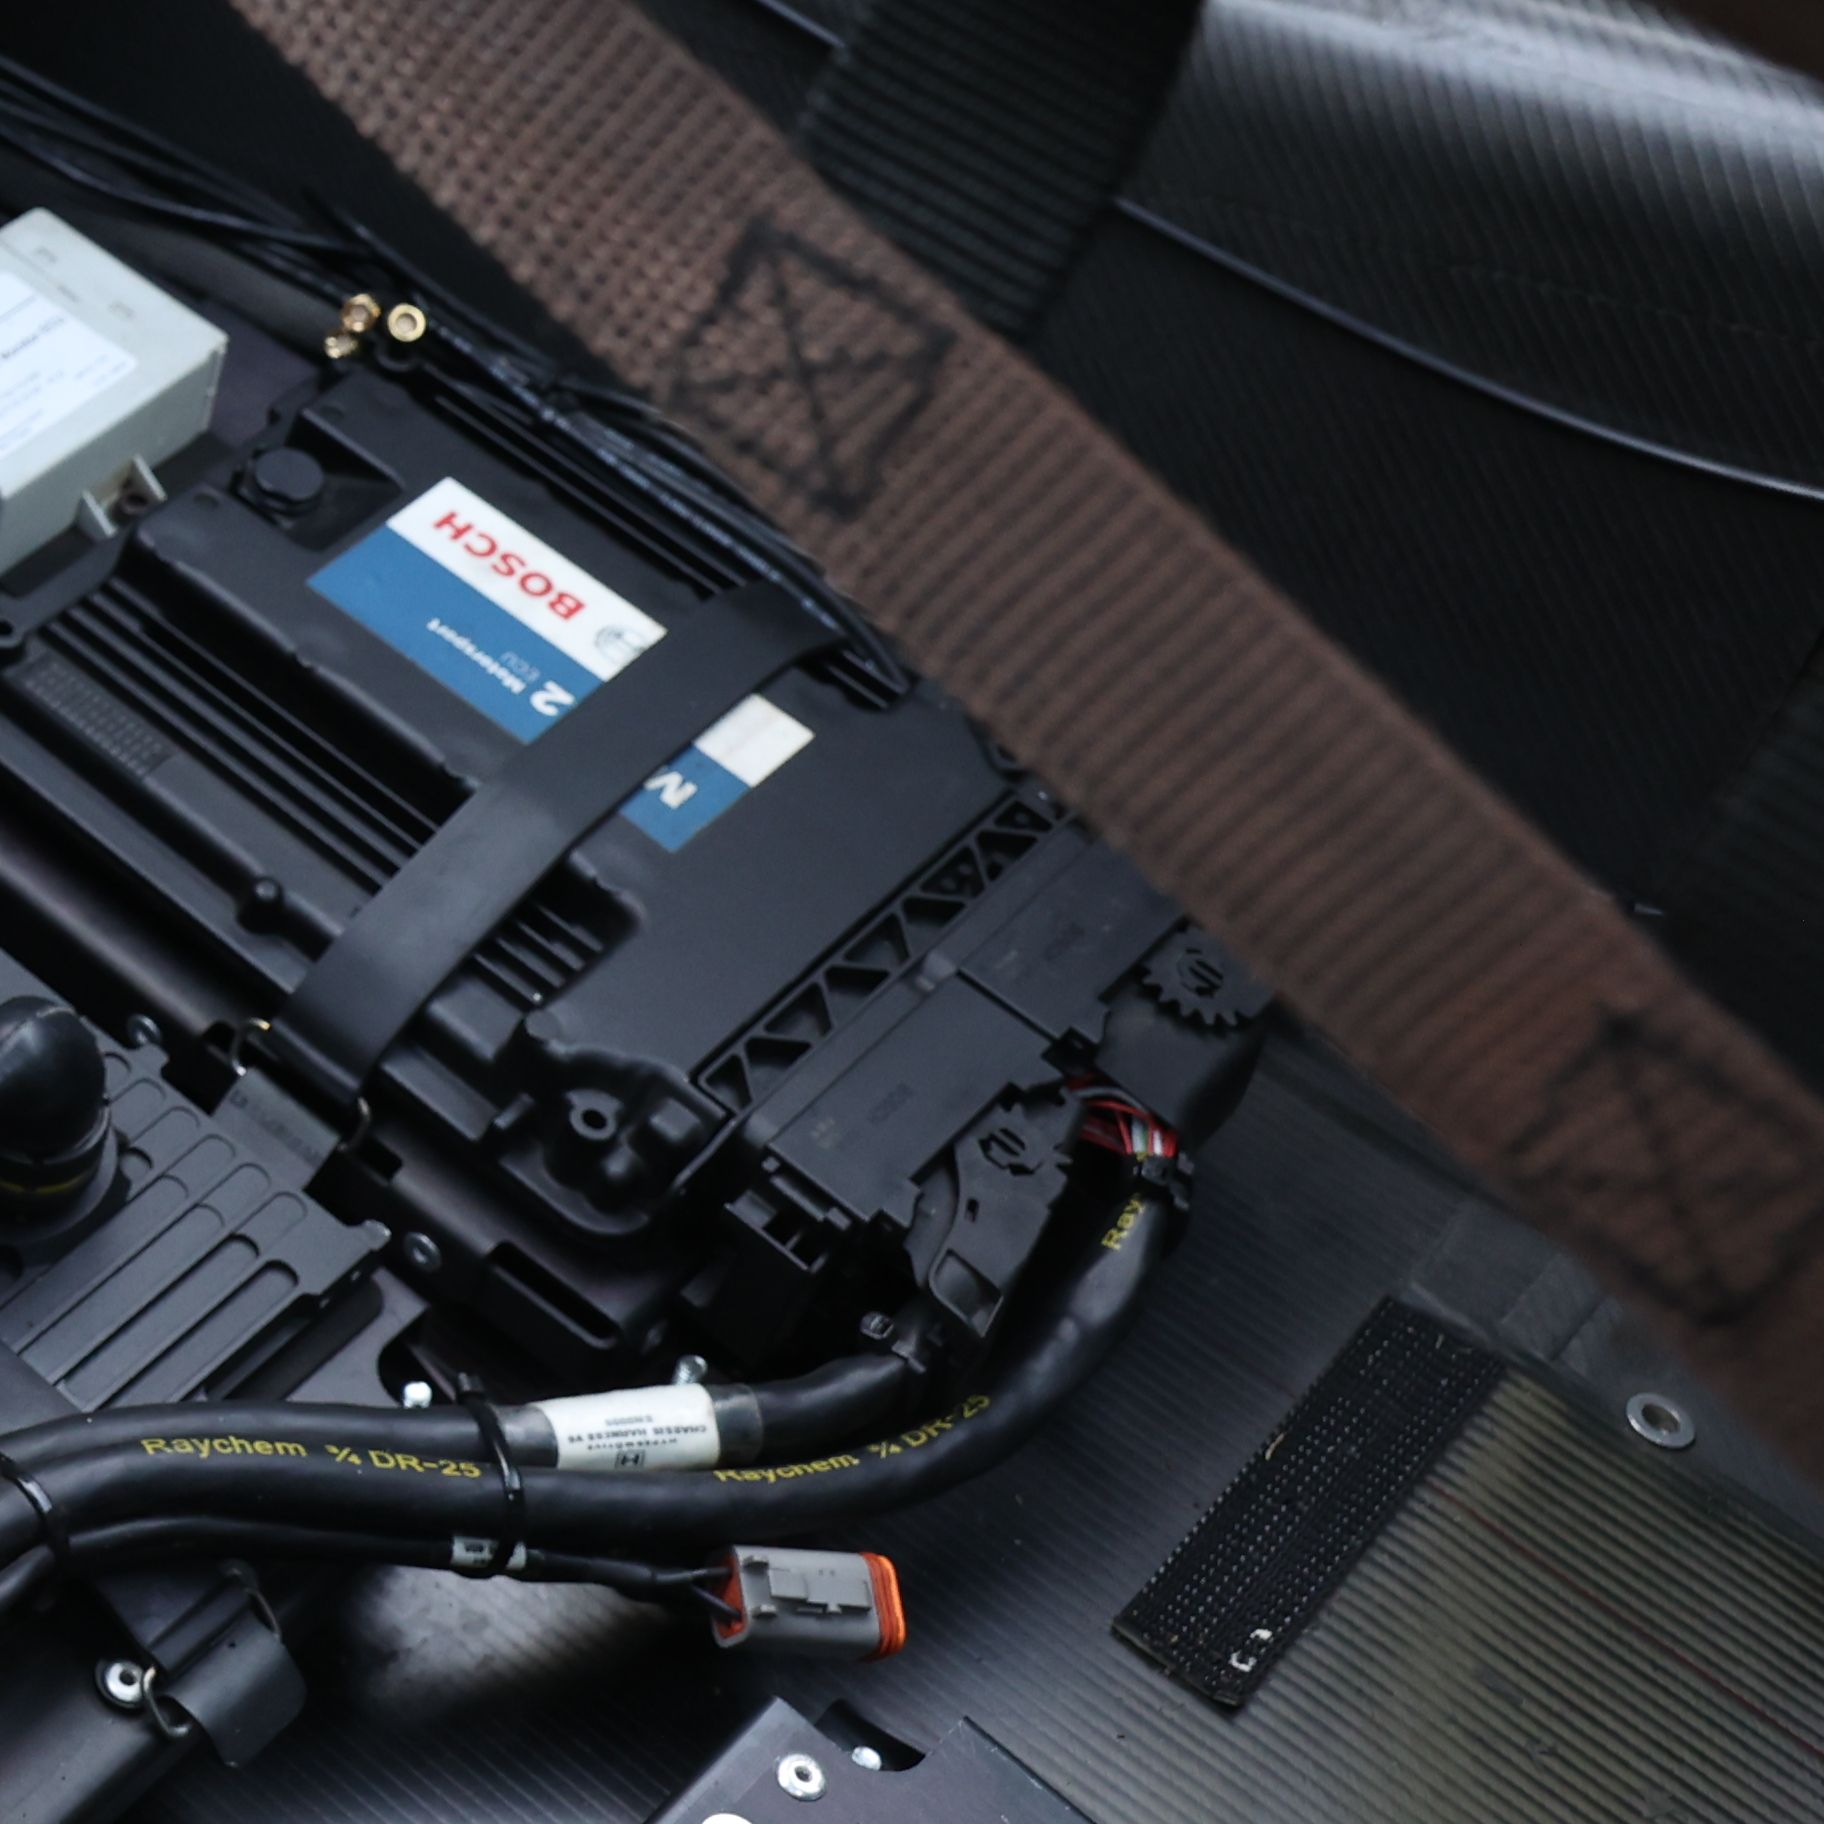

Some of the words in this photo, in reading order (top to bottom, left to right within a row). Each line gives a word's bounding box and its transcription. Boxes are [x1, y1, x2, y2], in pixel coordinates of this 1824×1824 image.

[432, 509, 585, 622] BOSCH
[426, 620, 525, 695] Motorsport
[140, 1435, 308, 1459] Raychem
[367, 1449, 483, 1479] DR-25
